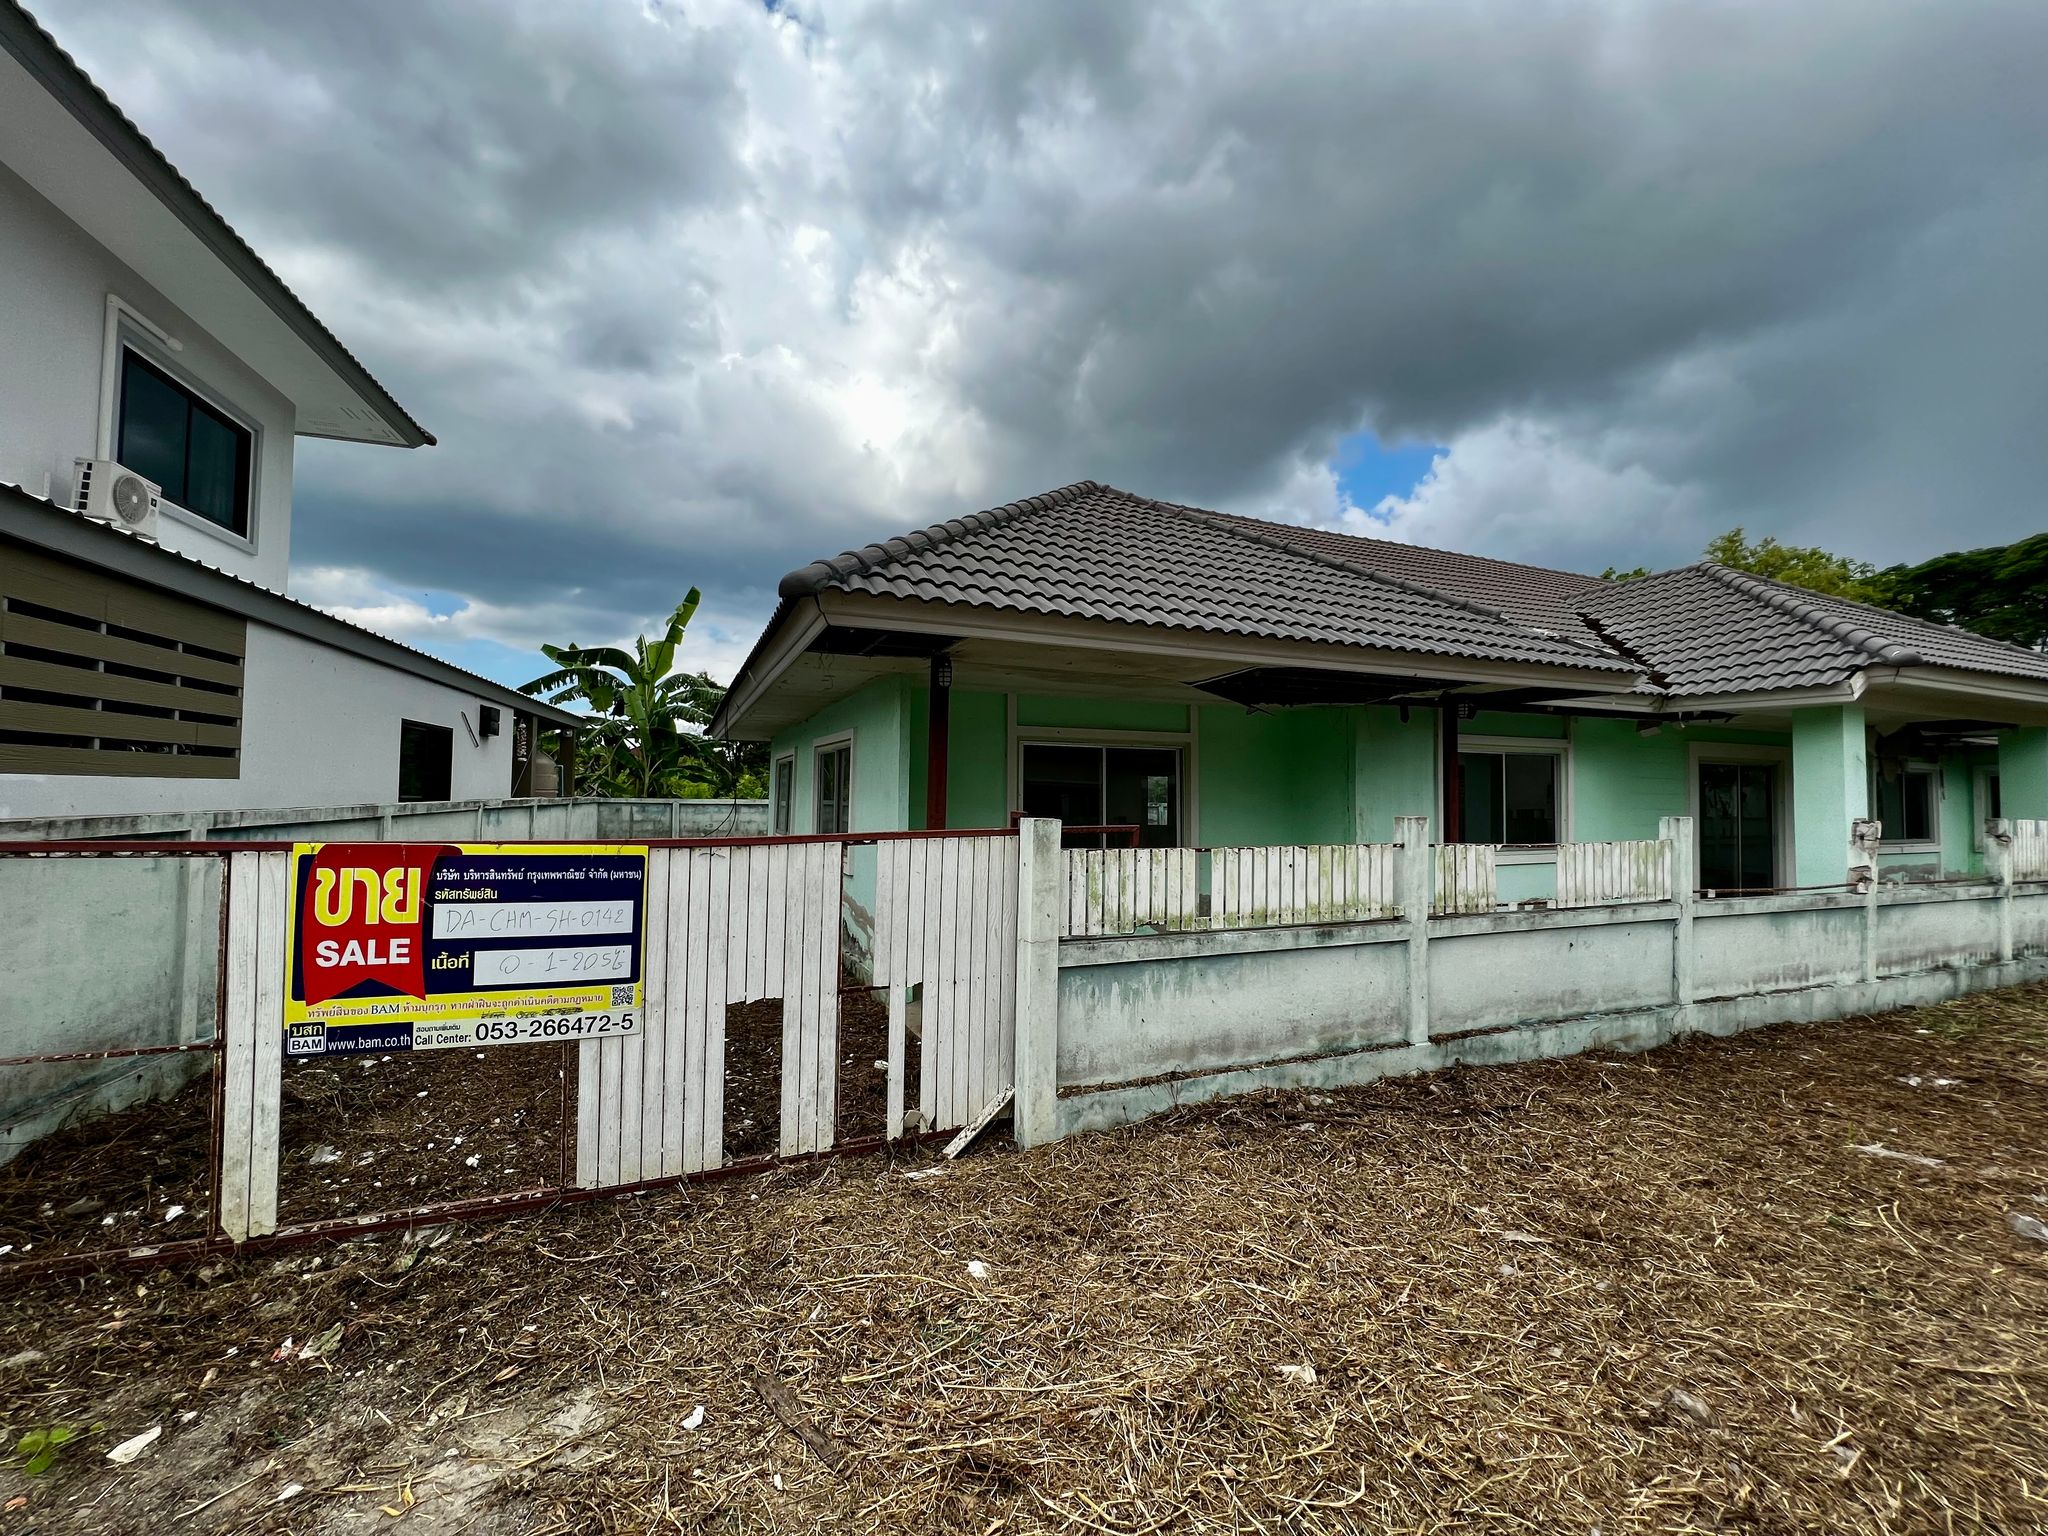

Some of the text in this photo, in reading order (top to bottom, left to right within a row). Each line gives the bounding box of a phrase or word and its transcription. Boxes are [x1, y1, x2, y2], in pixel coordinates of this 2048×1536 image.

[436, 868, 642, 884] บริษัท บริหารสินทรัพย์ กรุงเทพพาณิชย์ จำกัด (มหาชน)
[314, 867, 422, 927] ขาย
[434, 887, 498, 900] รหัสทรัพย์สิน
[315, 938, 411, 968] SALE
[431, 951, 470, 971] เนื้อที่
[307, 1005, 369, 1018] ทรัพย์สินของ
[371, 1003, 400, 1015] BAM
[403, 1001, 447, 1014] ห้ามบุกรุก
[291, 1024, 323, 1037] บสก
[475, 1013, 634, 1041] 053-266472-5
[291, 1038, 323, 1051] BAM
[328, 1033, 411, 1051] www.bam.co.th
[415, 1032, 472, 1046] Call Center:
